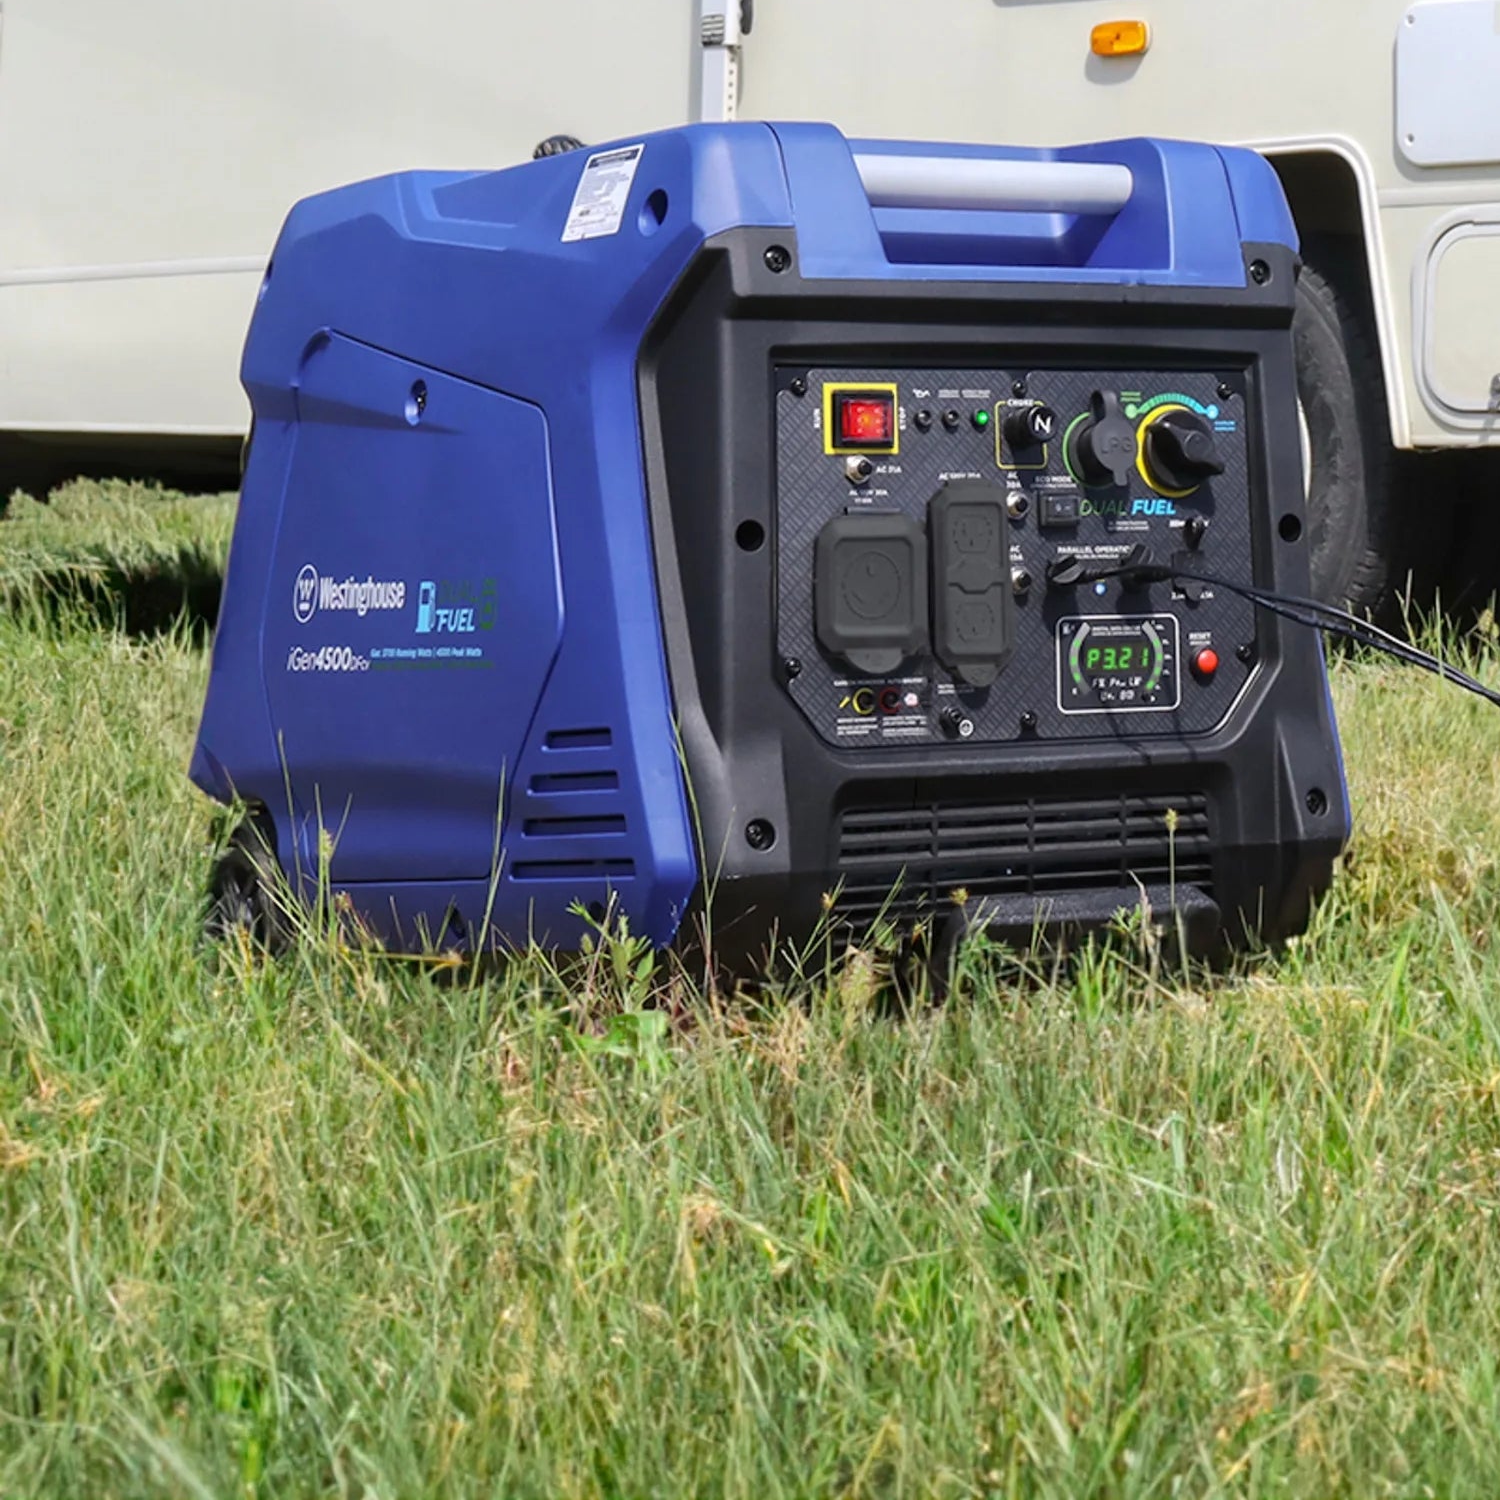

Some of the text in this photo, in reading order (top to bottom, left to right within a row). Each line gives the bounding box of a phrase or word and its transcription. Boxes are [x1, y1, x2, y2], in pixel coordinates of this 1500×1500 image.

[1079, 499, 1177, 516] DUAL FUEL
[319, 575, 406, 617] Westinghouse
[435, 607, 476, 632] FUEL
